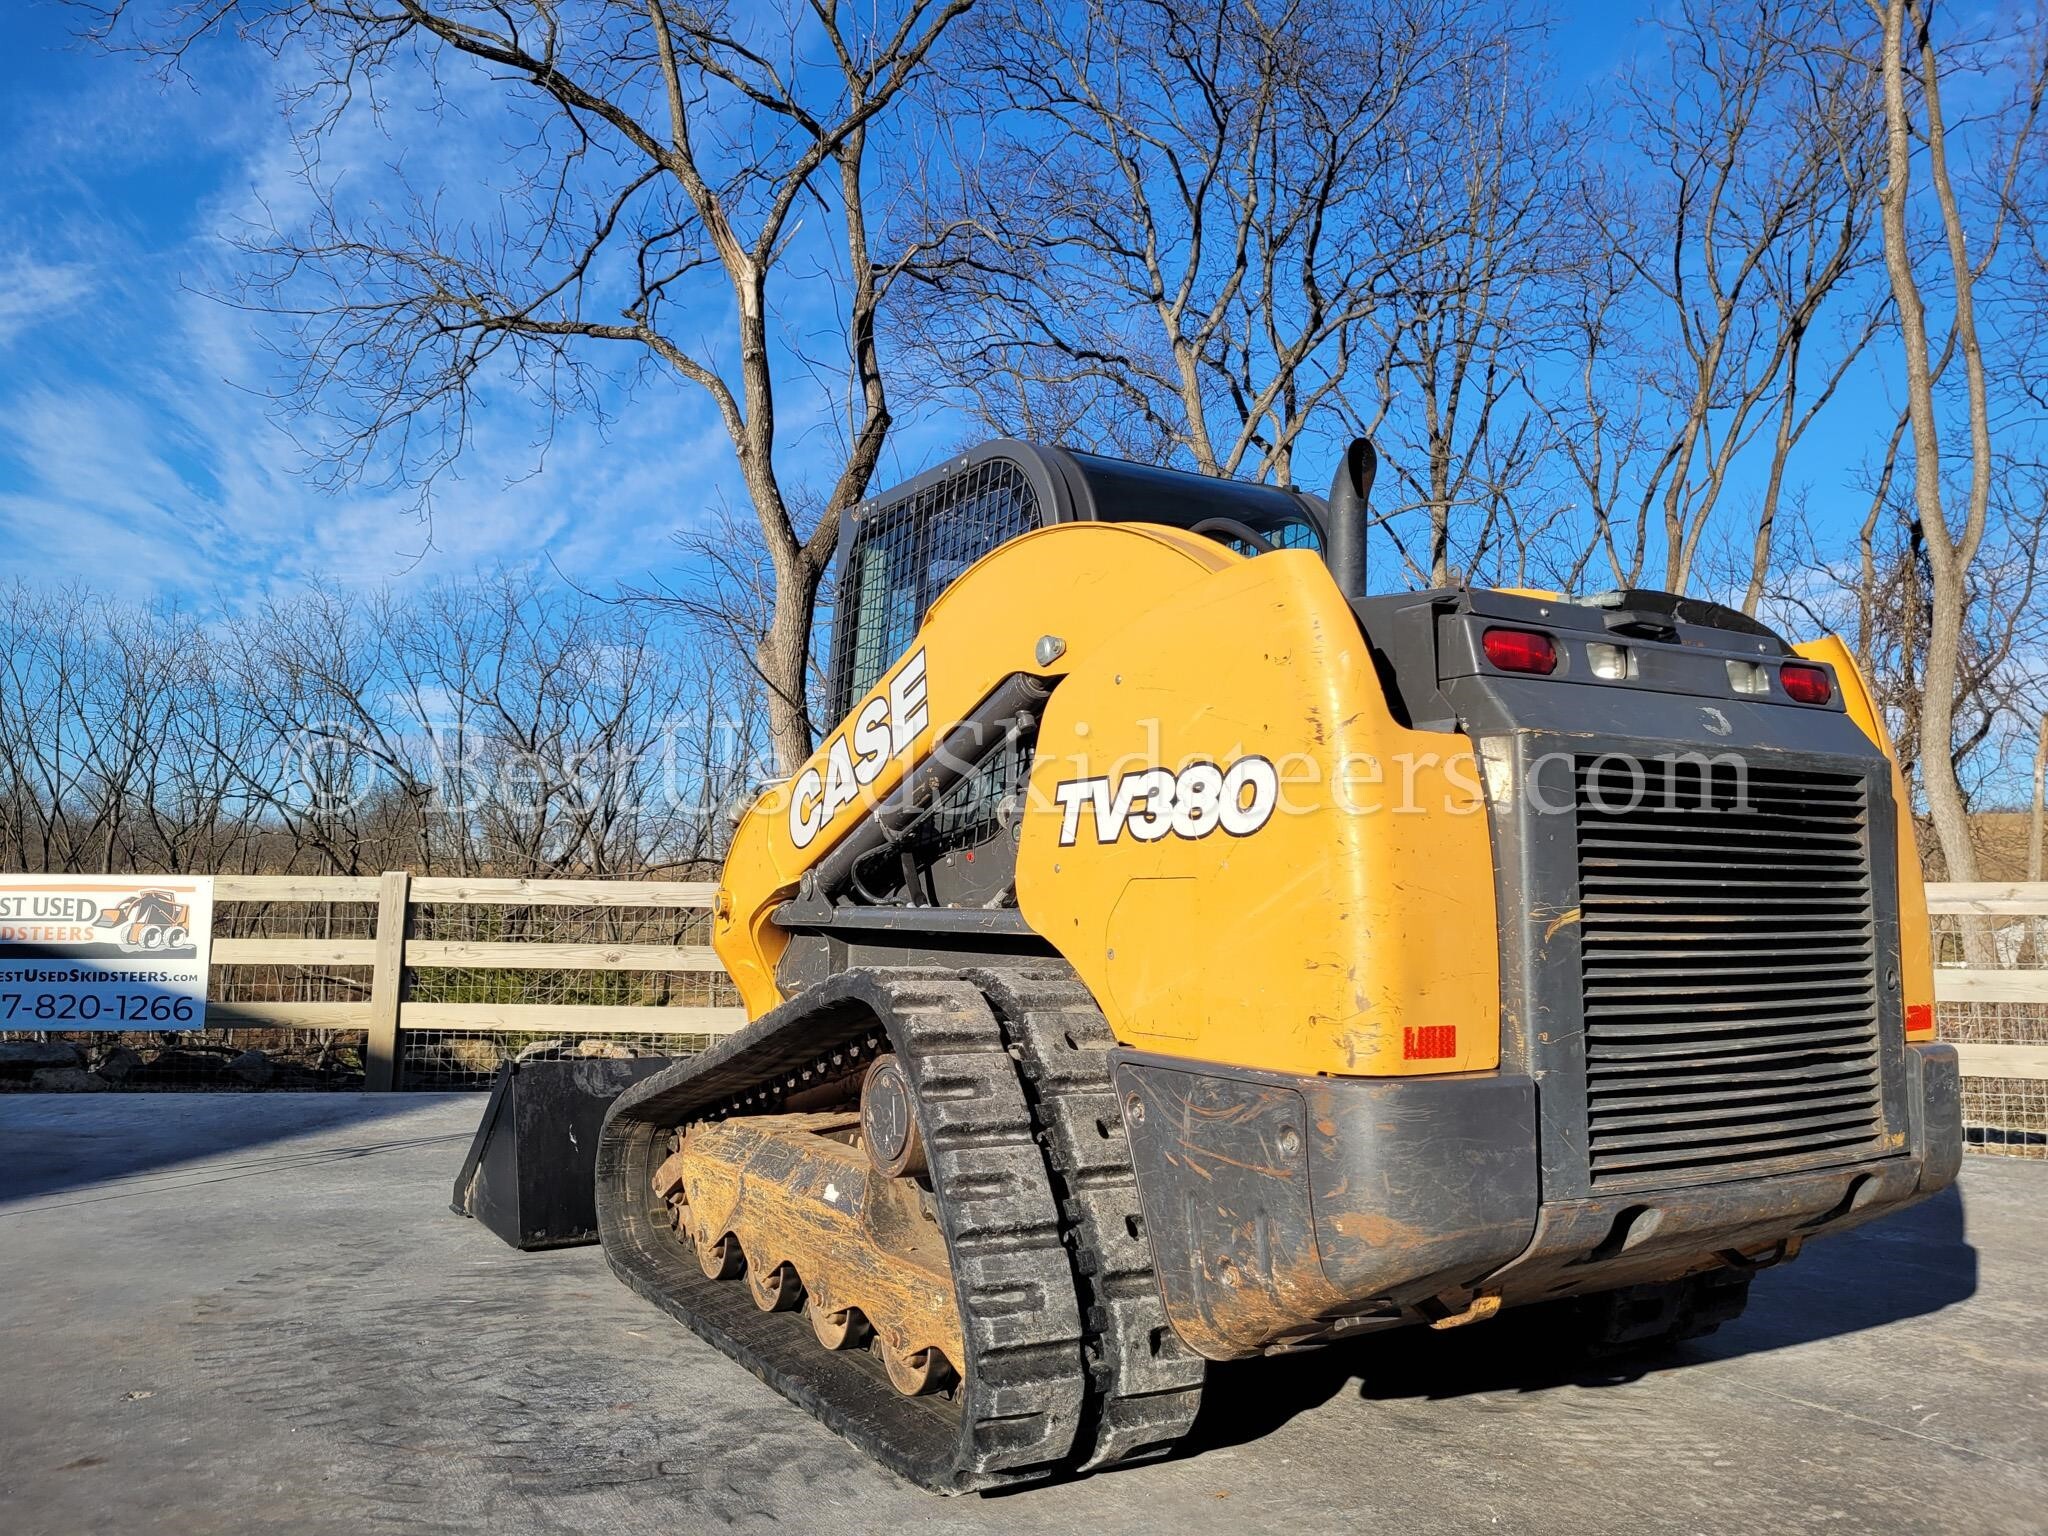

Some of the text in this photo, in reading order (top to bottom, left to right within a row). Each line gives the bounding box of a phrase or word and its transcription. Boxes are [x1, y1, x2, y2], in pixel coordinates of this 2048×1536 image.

[788, 647, 932, 849] CASE
[1056, 755, 1278, 847] TV380
[33, 897, 97, 922] USED
[1, 926, 94, 941] DSTEERS
[2, 993, 193, 1021] 7-820-1266
